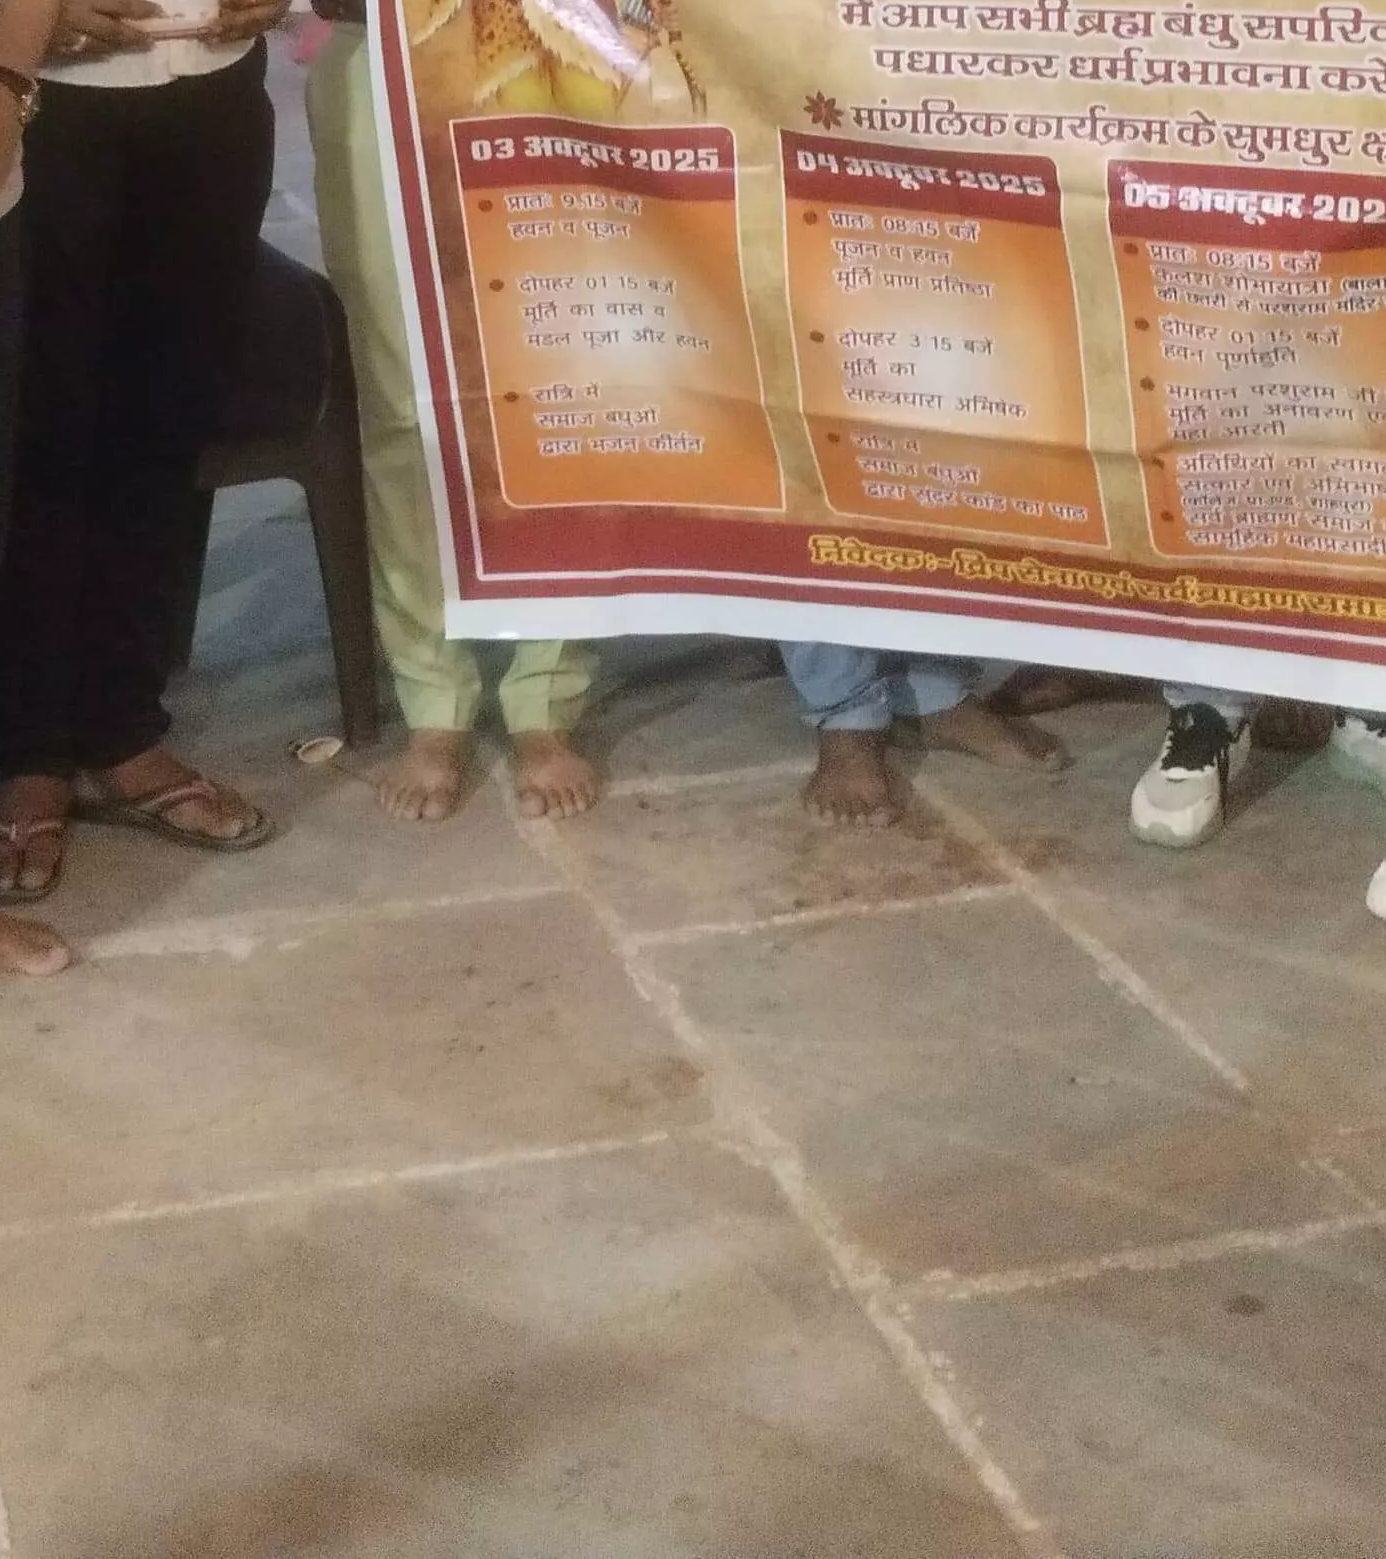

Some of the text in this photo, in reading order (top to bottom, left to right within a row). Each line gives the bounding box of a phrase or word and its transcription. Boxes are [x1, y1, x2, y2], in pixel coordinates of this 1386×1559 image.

[881, 3, 969, 28] आप
[1162, 3, 1239, 48] बंधु
[873, 49, 1060, 79] पधारकर
[1068, 47, 1143, 82] धर्म
[1141, 56, 1313, 90] प्रभावना
[849, 98, 1010, 137] मांगलिक
[1014, 105, 1170, 146] कार्यक्रम
[1176, 109, 1216, 146] के
[1222, 122, 1353, 166] सुमधुर
[471, 137, 516, 161] 03
[629, 147, 719, 172] 2025
[797, 149, 839, 174] 04
[955, 169, 1046, 197] 2025
[1124, 183, 1172, 209] 05
[509, 220, 631, 240] हवन व पूजन
[831, 238, 952, 266] पूजन व हवन
[518, 275, 575, 293] दोपहर
[834, 265, 873, 292] मूर्ति
[881, 272, 921, 290] प्राण
[522, 299, 558, 325] मूर्ति
[569, 303, 595, 317] का
[581, 328, 620, 349] पूजा
[631, 326, 667, 344] और
[676, 334, 711, 351] हवन
[839, 328, 897, 348] दोपहर
[1158, 315, 1221, 340] दोपहर
[842, 356, 917, 379] मूर्ति का
[532, 381, 601, 402] रात्रि में
[534, 411, 597, 428] समाज
[589, 436, 639, 452] भजन
[645, 430, 705, 453] कीर्तन
